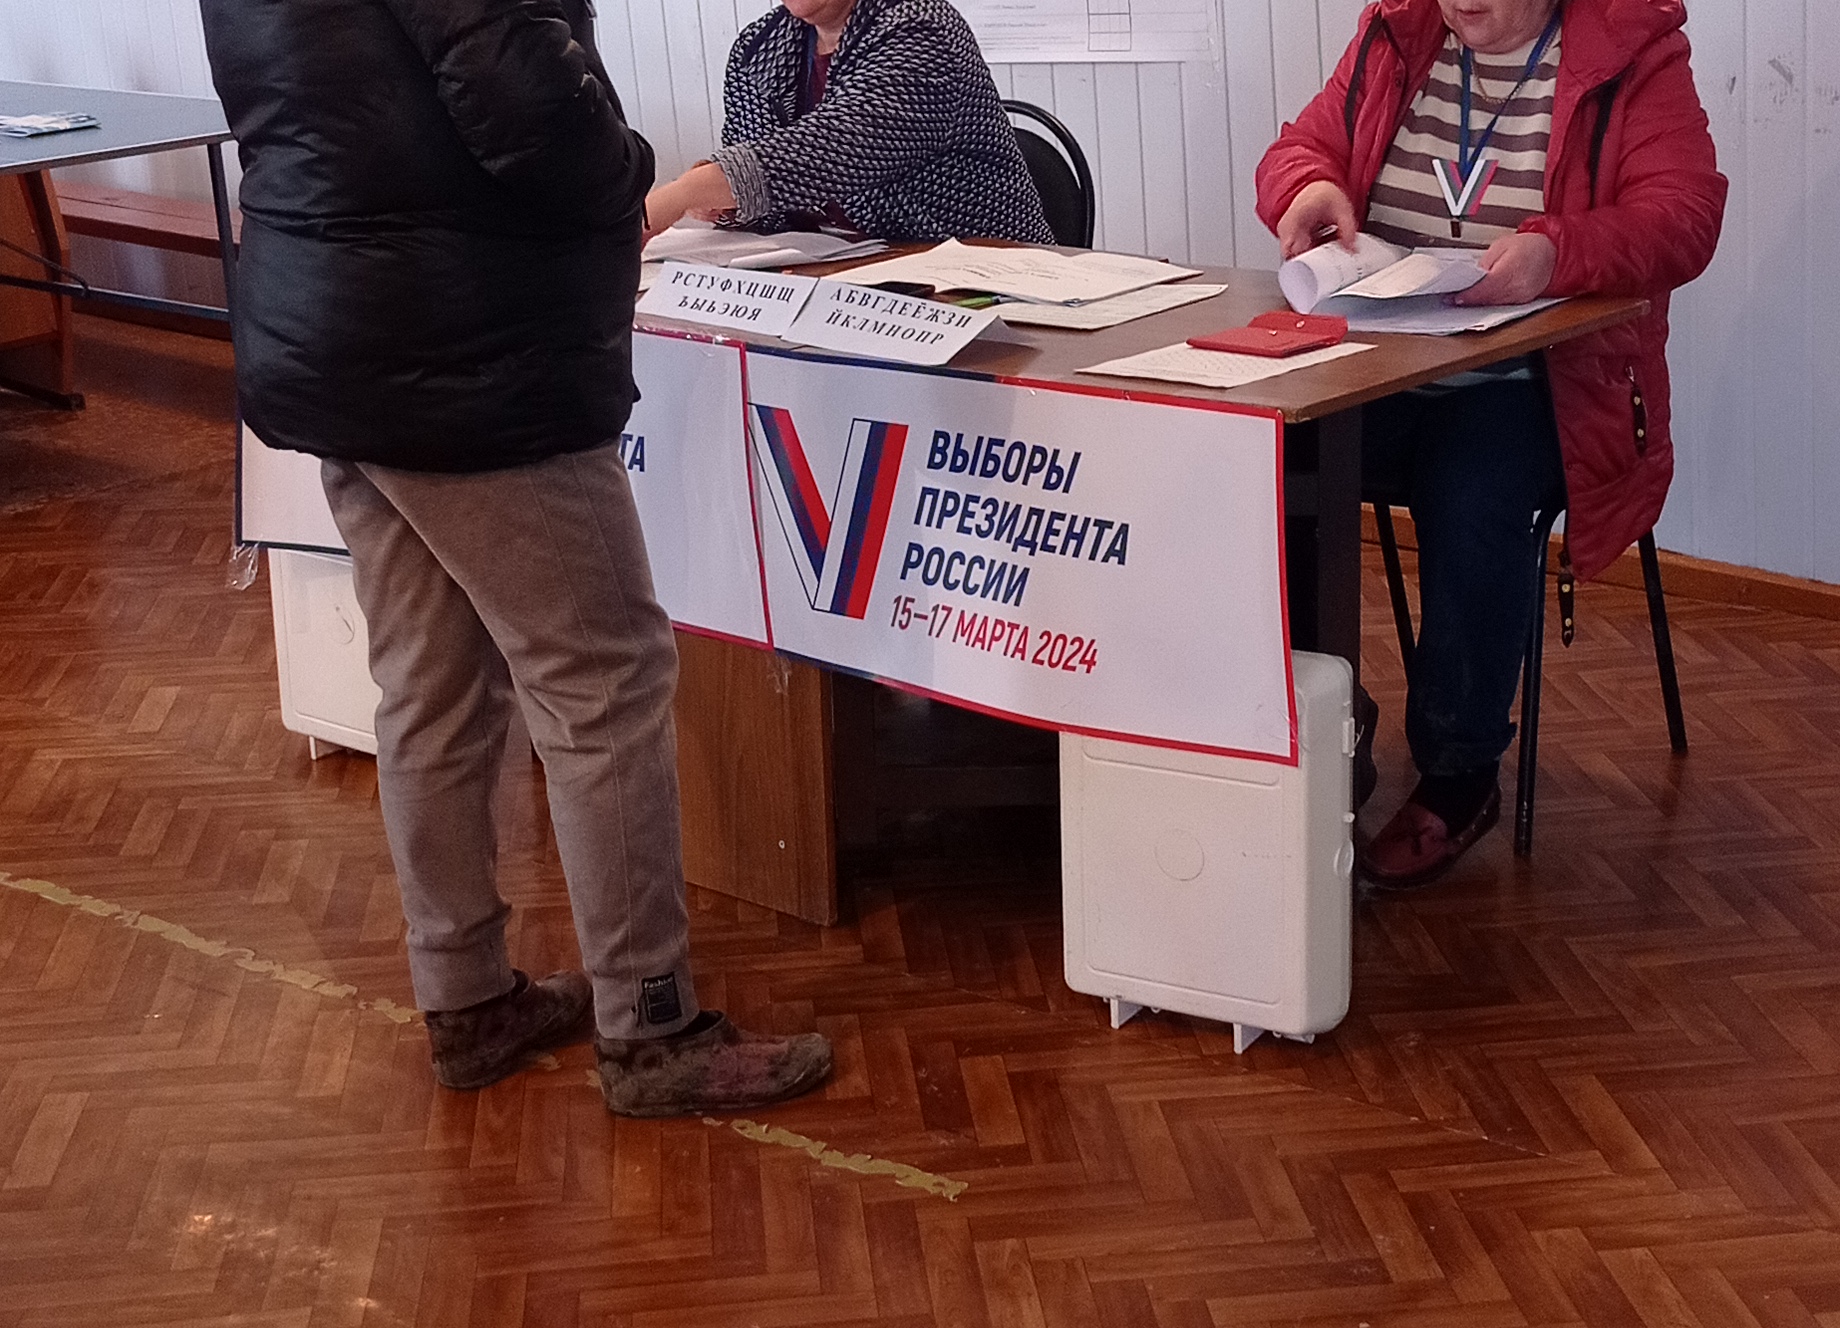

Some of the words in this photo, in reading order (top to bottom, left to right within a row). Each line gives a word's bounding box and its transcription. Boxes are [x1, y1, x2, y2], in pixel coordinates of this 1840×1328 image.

[671, 270, 796, 303] РСТУФХЦШЩ
[677, 294, 763, 322] ЪЫЬЭЮЯ
[829, 286, 974, 329] АБВГДЕЁЖЗИ
[825, 310, 945, 345] ЙКЛМНОПР
[926, 429, 1082, 494] ВЫБОРЫ
[913, 486, 1130, 566] ПРЕЗИДЕНТА
[899, 541, 1031, 607] РОССИИ
[952, 609, 1029, 661] МАРТА
[1031, 630, 1098, 674] 2024
